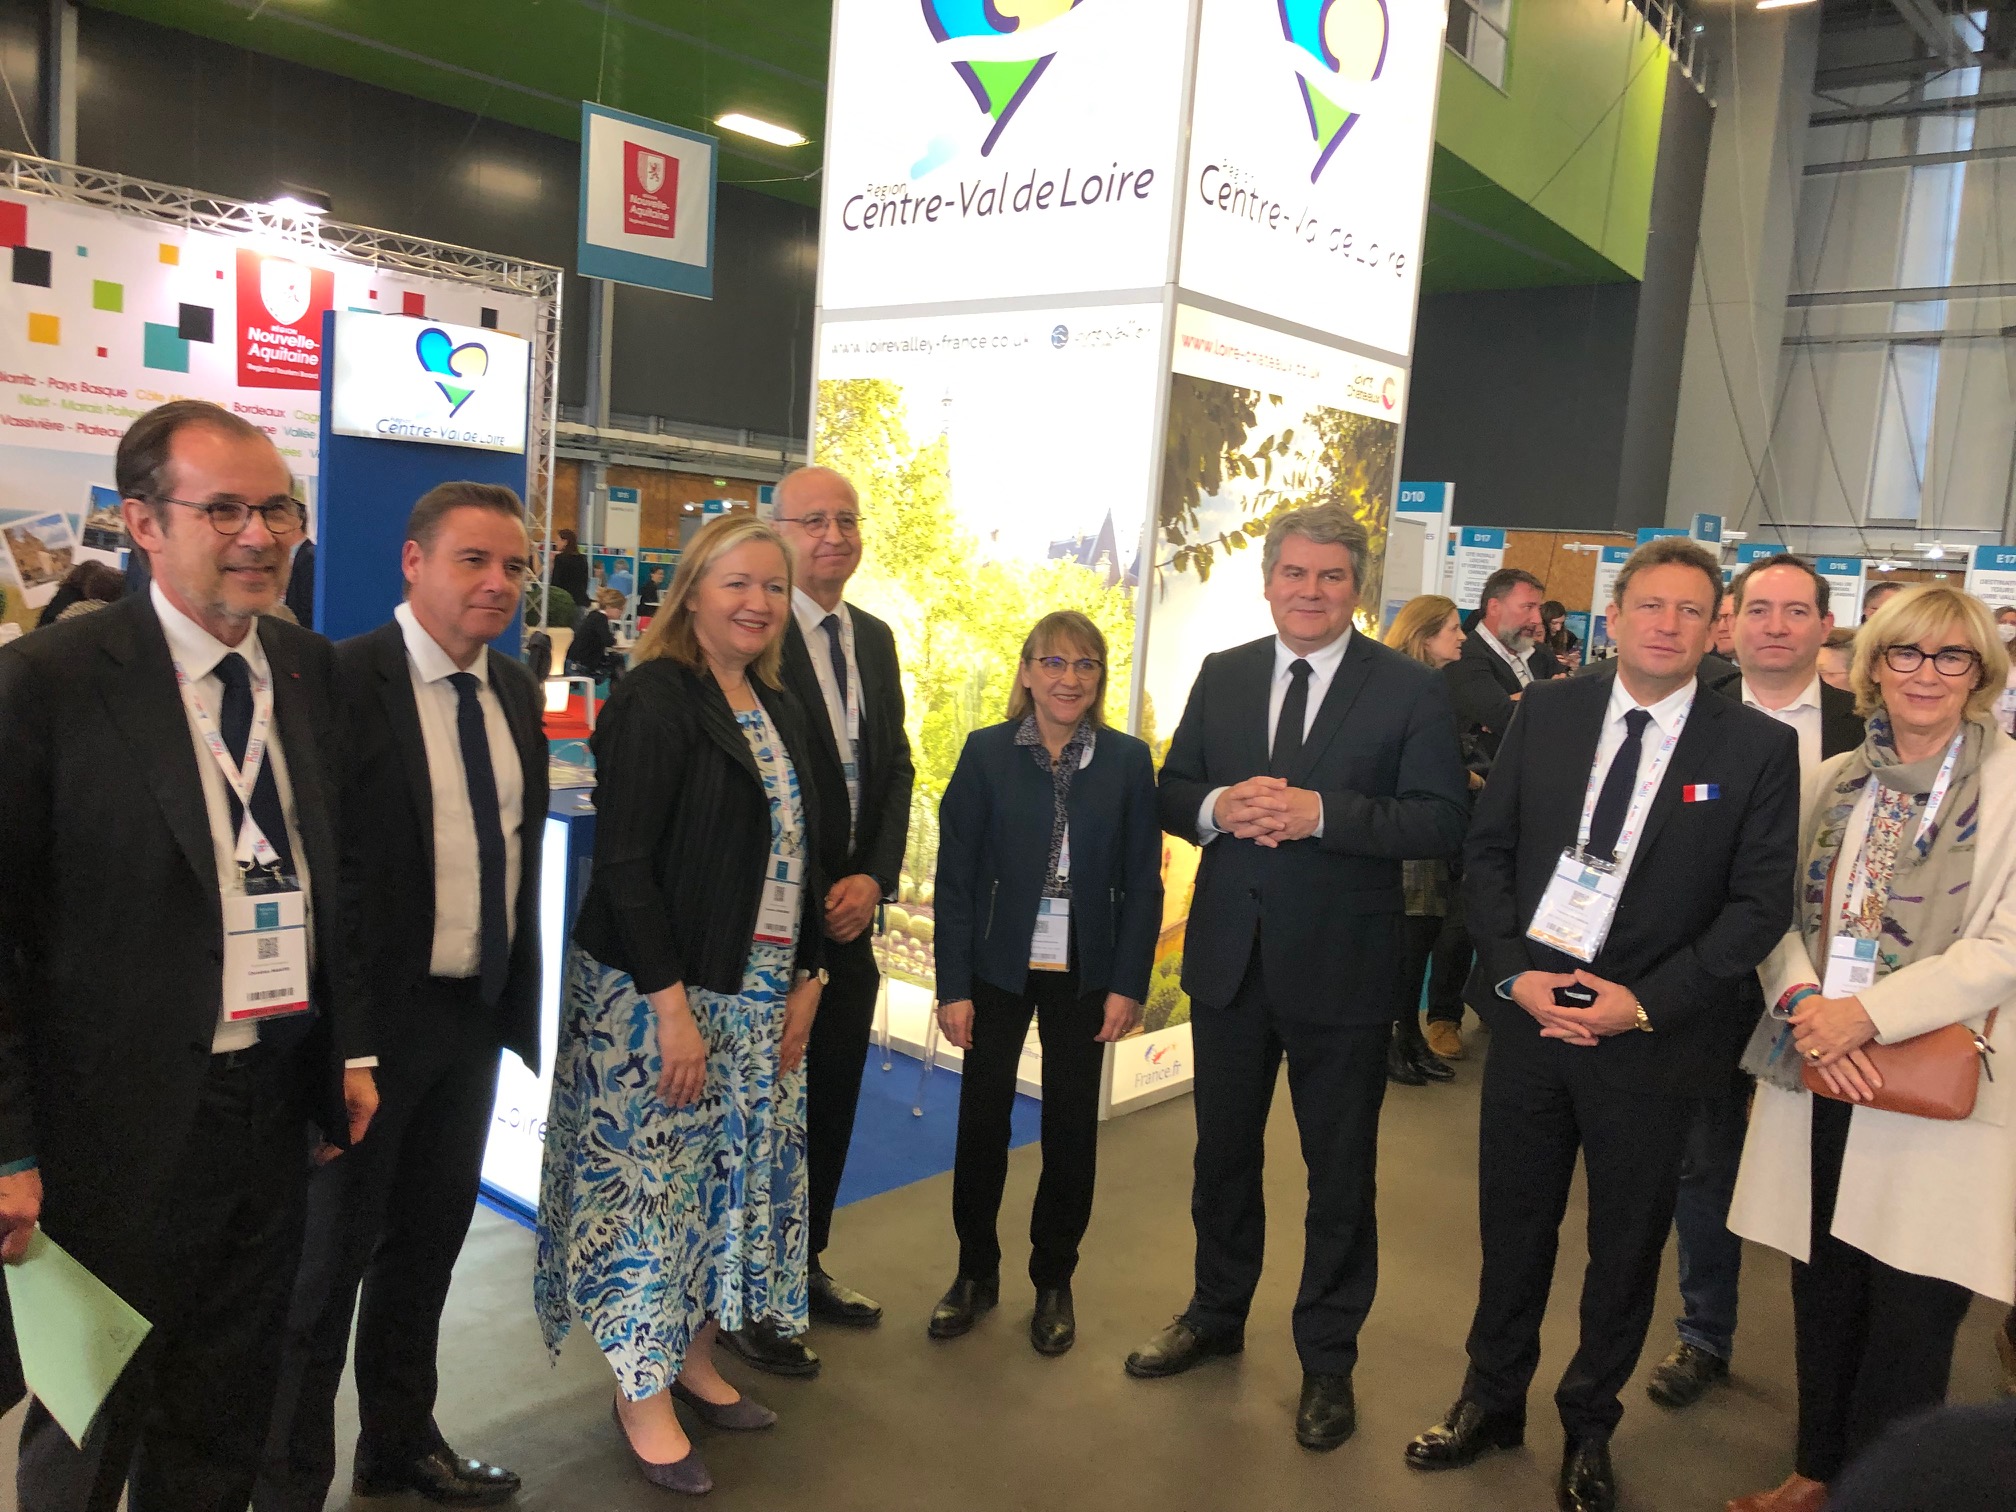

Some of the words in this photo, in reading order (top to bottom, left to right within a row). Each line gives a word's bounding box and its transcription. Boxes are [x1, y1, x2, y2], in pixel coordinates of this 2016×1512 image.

[843, 172, 1009, 231] Centre-Val
[1013, 168, 1054, 213] de
[1060, 162, 1155, 207] Loire
[1200, 164, 1319, 244] Centre-Va
[630, 205, 670, 221] Aquitaine
[247, 326, 320, 350] Nouvelle-
[832, 332, 1029, 355] wwwloirevalley-francecou
[247, 342, 319, 366] Aquitaine
[48, 376, 78, 393] Pays
[80, 381, 128, 399] Basque
[233, 401, 286, 418] Bordeaux
[75, 421, 125, 438] Plateau
[1401, 490, 1426, 503] D10
[1473, 533, 1492, 542] D17
[1996, 554, 2016, 565] E17
[1134, 1060, 1182, 1089] France.fr
[497, 1107, 549, 1144] oire
